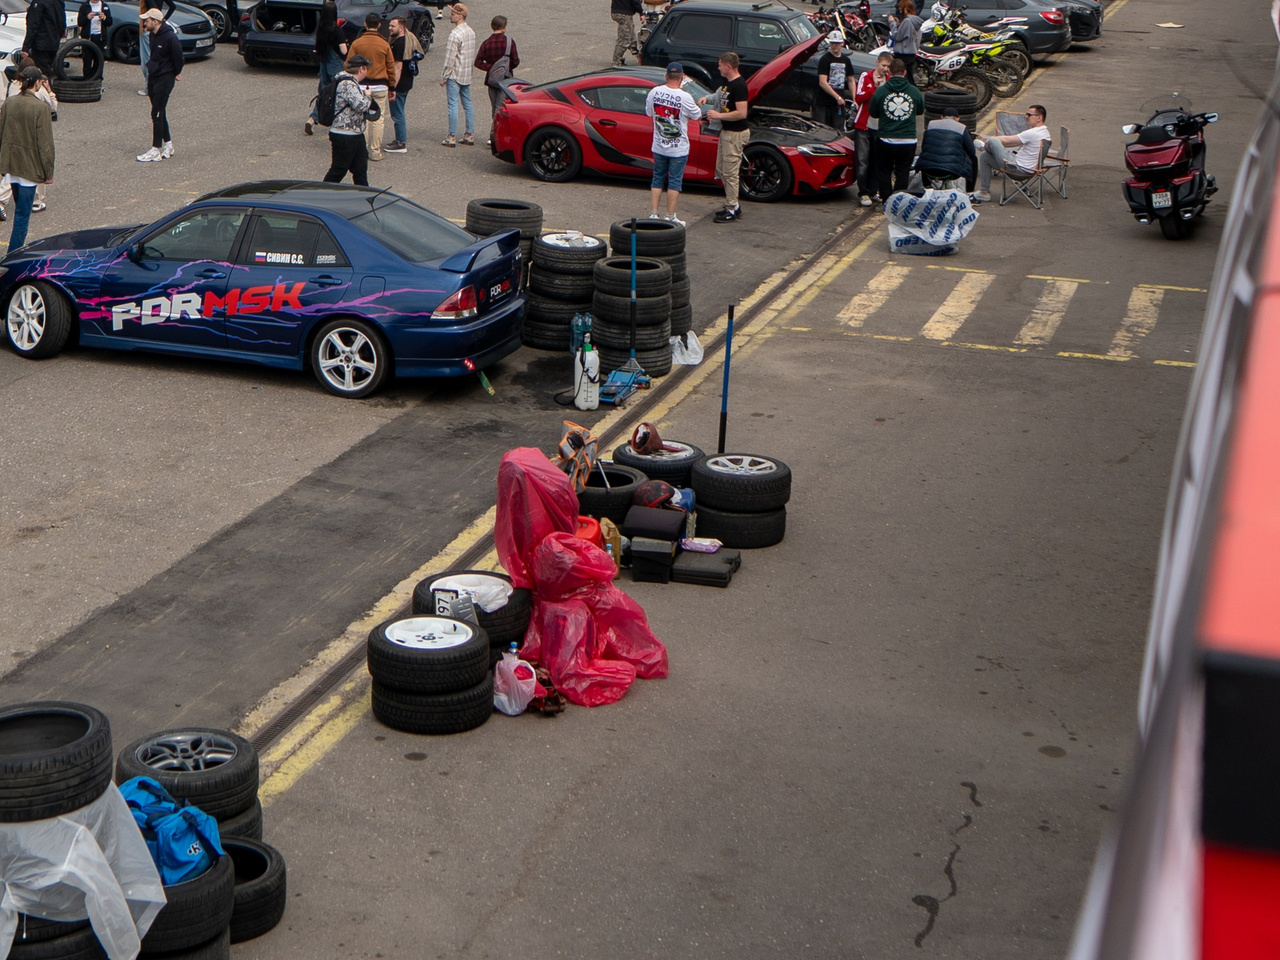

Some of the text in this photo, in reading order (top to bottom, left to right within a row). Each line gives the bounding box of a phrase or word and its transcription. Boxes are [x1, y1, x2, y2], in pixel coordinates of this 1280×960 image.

[948, 58, 962, 69] 66
[653, 96, 682, 109] DRIFTING
[266, 252, 291, 264] СИВИН
